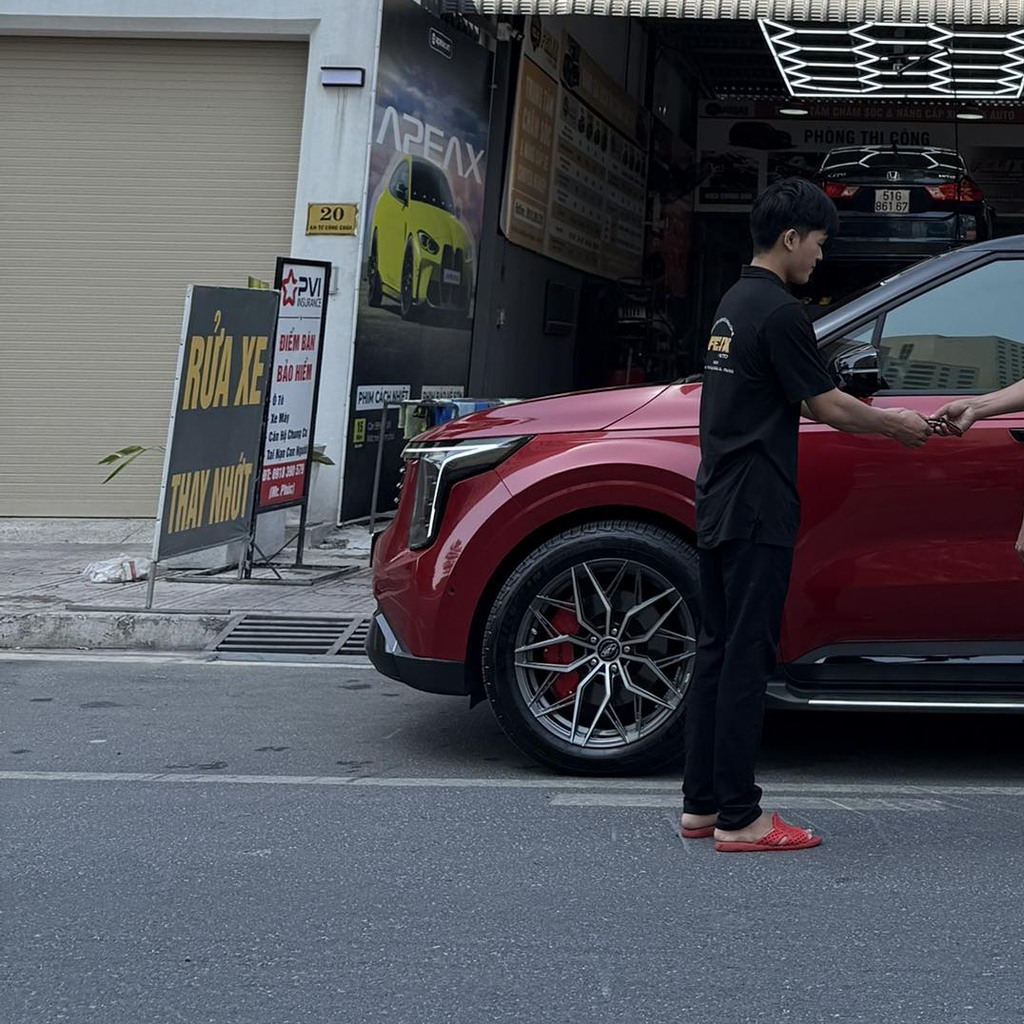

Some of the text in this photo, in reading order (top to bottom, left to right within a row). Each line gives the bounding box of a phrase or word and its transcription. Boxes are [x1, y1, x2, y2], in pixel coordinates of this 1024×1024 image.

[804, 128, 855, 144] PHÒNG
[860, 130, 883, 145] THI
[883, 191, 902, 201] 51G
[320, 207, 344, 221] 20
[875, 202, 908, 212] 861.67
[298, 276, 321, 297] PVI
[279, 327, 300, 351] ĐIỂM
[182, 310, 268, 410] RỬA XE
[277, 357, 312, 382] BẢO HIỂM
[358, 390, 374, 405] PHIM
[270, 414, 278, 424] Xe
[168, 452, 253, 534] THAY NHỚT
